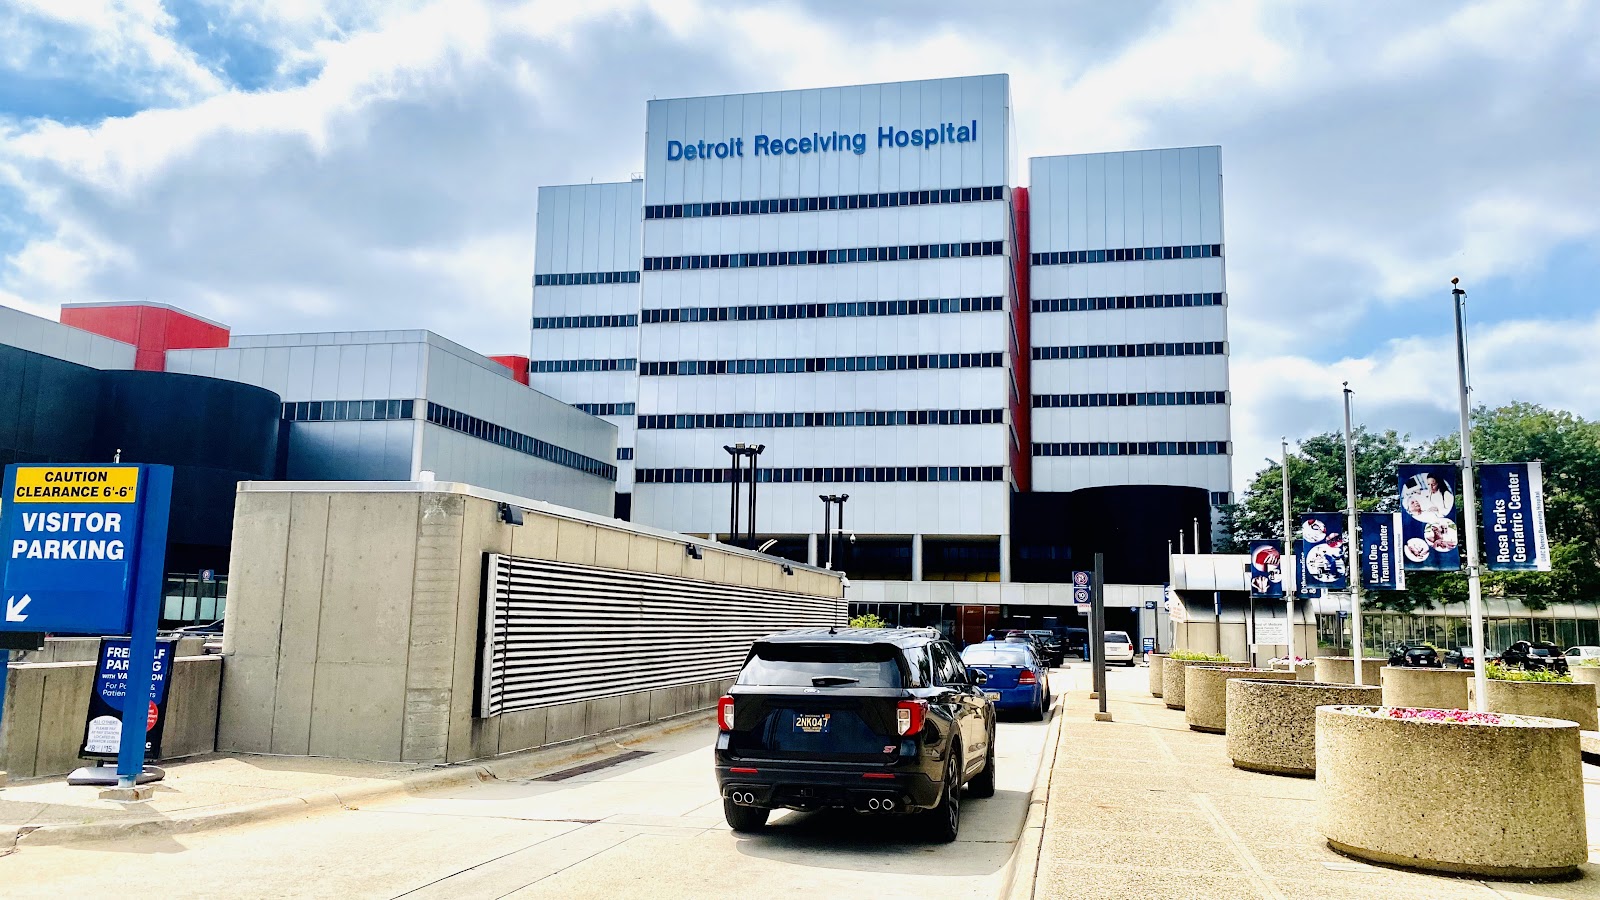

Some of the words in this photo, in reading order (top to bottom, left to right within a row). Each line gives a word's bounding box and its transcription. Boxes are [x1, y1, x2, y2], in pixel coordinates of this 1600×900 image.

[667, 137, 744, 161] Detroit
[754, 131, 866, 157] Receiving
[878, 120, 977, 149] Hospital
[44, 471, 108, 482] CAUTION
[16, 486, 99, 497] CLEARANCE
[103, 486, 134, 497] 6'-6"
[1508, 472, 1522, 510] Center
[22, 512, 121, 532] VISITOR
[1492, 499, 1508, 532] Parks
[11, 539, 124, 560] PARKING
[1379, 525, 1388, 552] Center
[1496, 535, 1511, 563] Rosa
[1509, 512, 1527, 563] Geriatric
[1368, 544, 1378, 560] One
[1368, 562, 1379, 584] Level
[1380, 553, 1390, 583] Trauma
[107, 647, 130, 658] FRE
